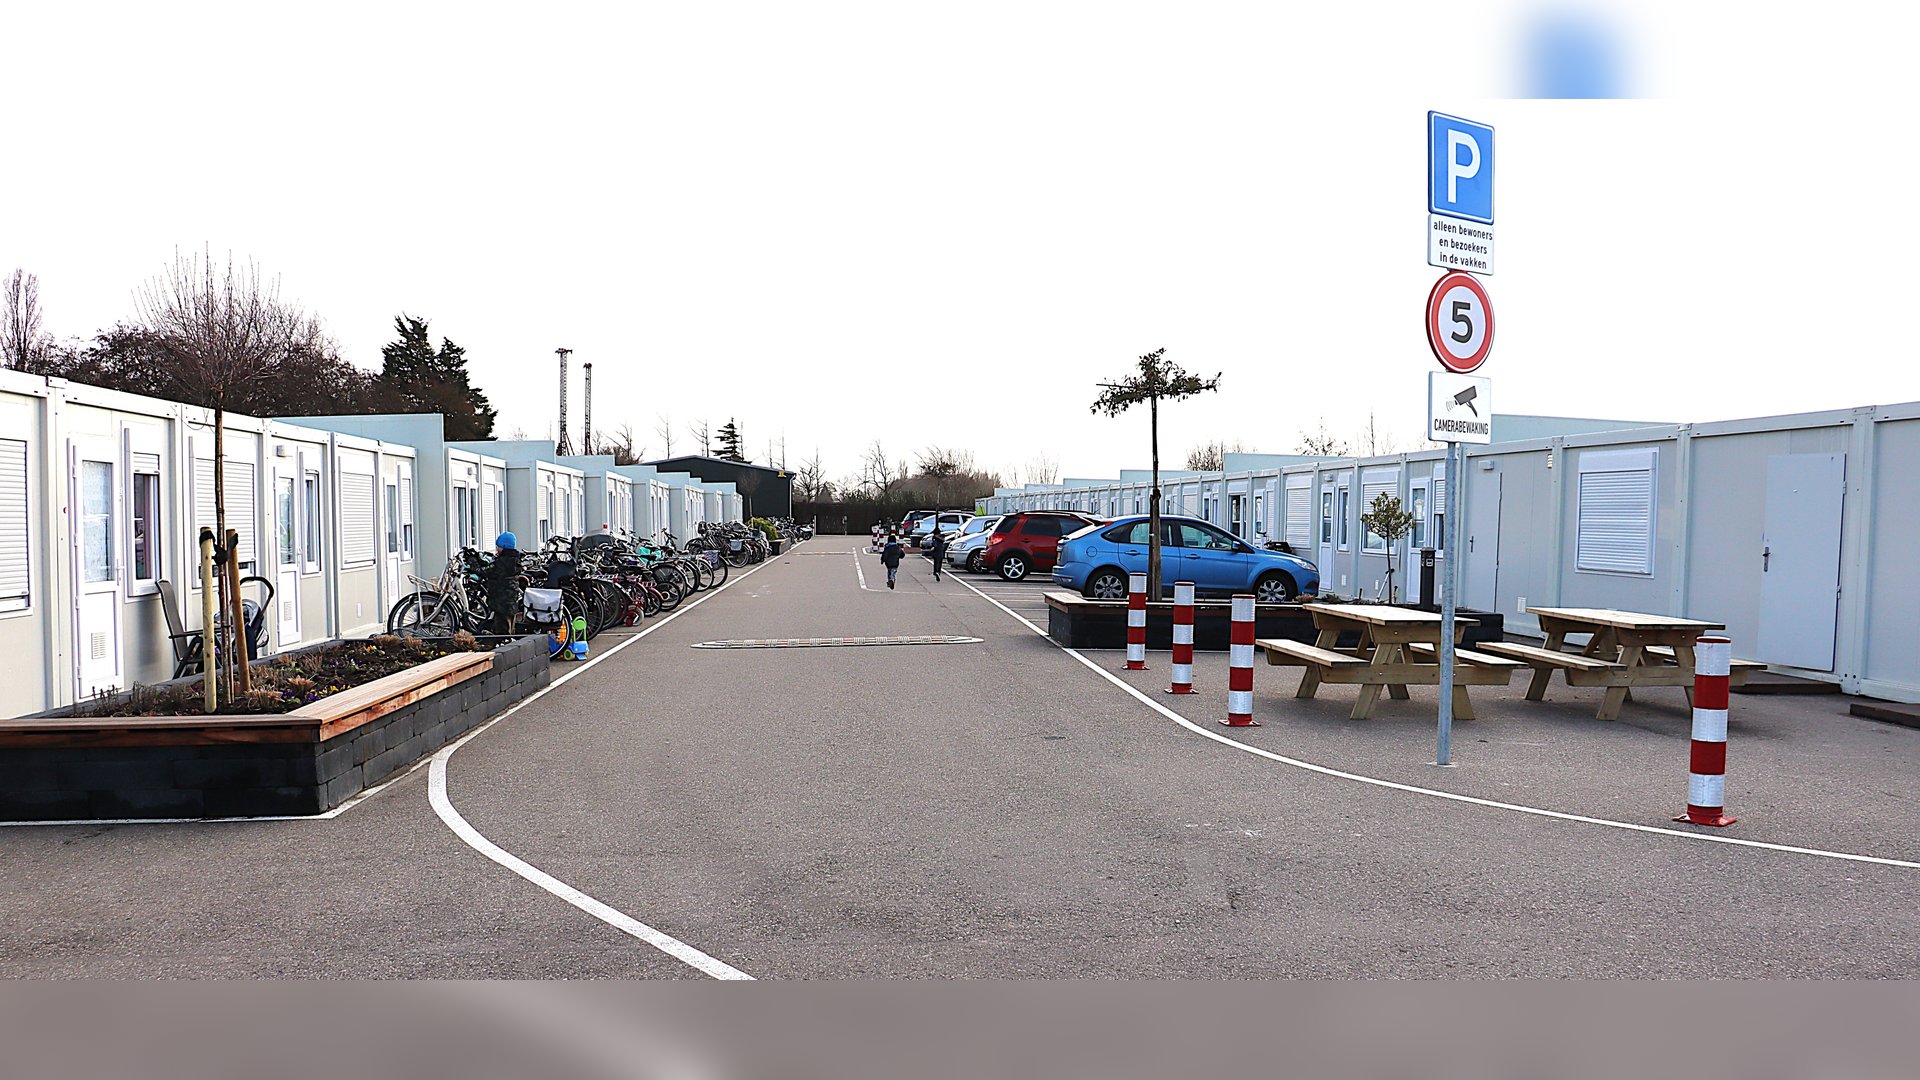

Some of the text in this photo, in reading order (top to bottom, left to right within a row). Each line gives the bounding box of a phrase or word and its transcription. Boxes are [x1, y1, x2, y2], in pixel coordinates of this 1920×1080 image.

[1448, 129, 1481, 203] P
[1433, 220, 1493, 241] alleen bewoners
[1439, 238, 1488, 254] en bezoekers
[1440, 252, 1487, 269] in de vakken
[1451, 301, 1473, 343] 5
[1434, 418, 1489, 435] CAMERABEWAKING
